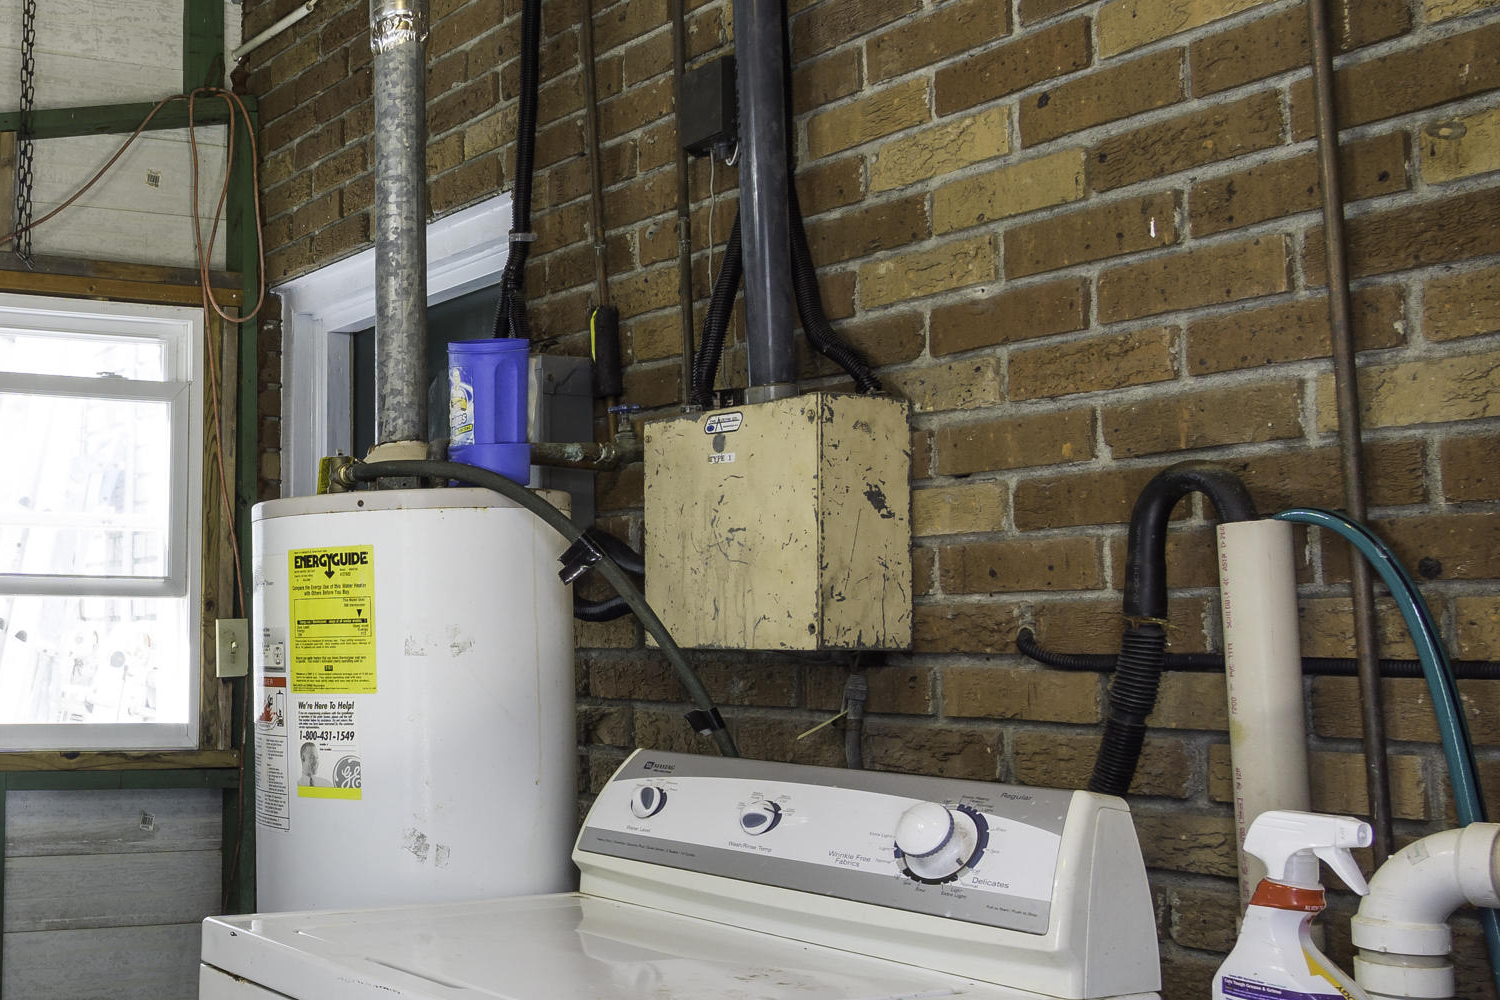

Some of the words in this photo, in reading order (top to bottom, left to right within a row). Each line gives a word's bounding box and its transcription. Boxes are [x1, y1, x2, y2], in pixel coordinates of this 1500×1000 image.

[294, 551, 368, 570] ENERGYGUIDE
[298, 701, 312, 709] We're
[314, 701, 327, 709] Here
[329, 701, 336, 709] To
[337, 701, 354, 711] Help!
[299, 731, 355, 741] 1-800-431-1549
[1001, 792, 1033, 801] Regular
[759, 845, 772, 853] Temp
[828, 850, 854, 860] Wrinkle
[855, 854, 871, 862] Free
[835, 858, 860, 867] Fabrics
[972, 877, 1009, 889] Delicates
